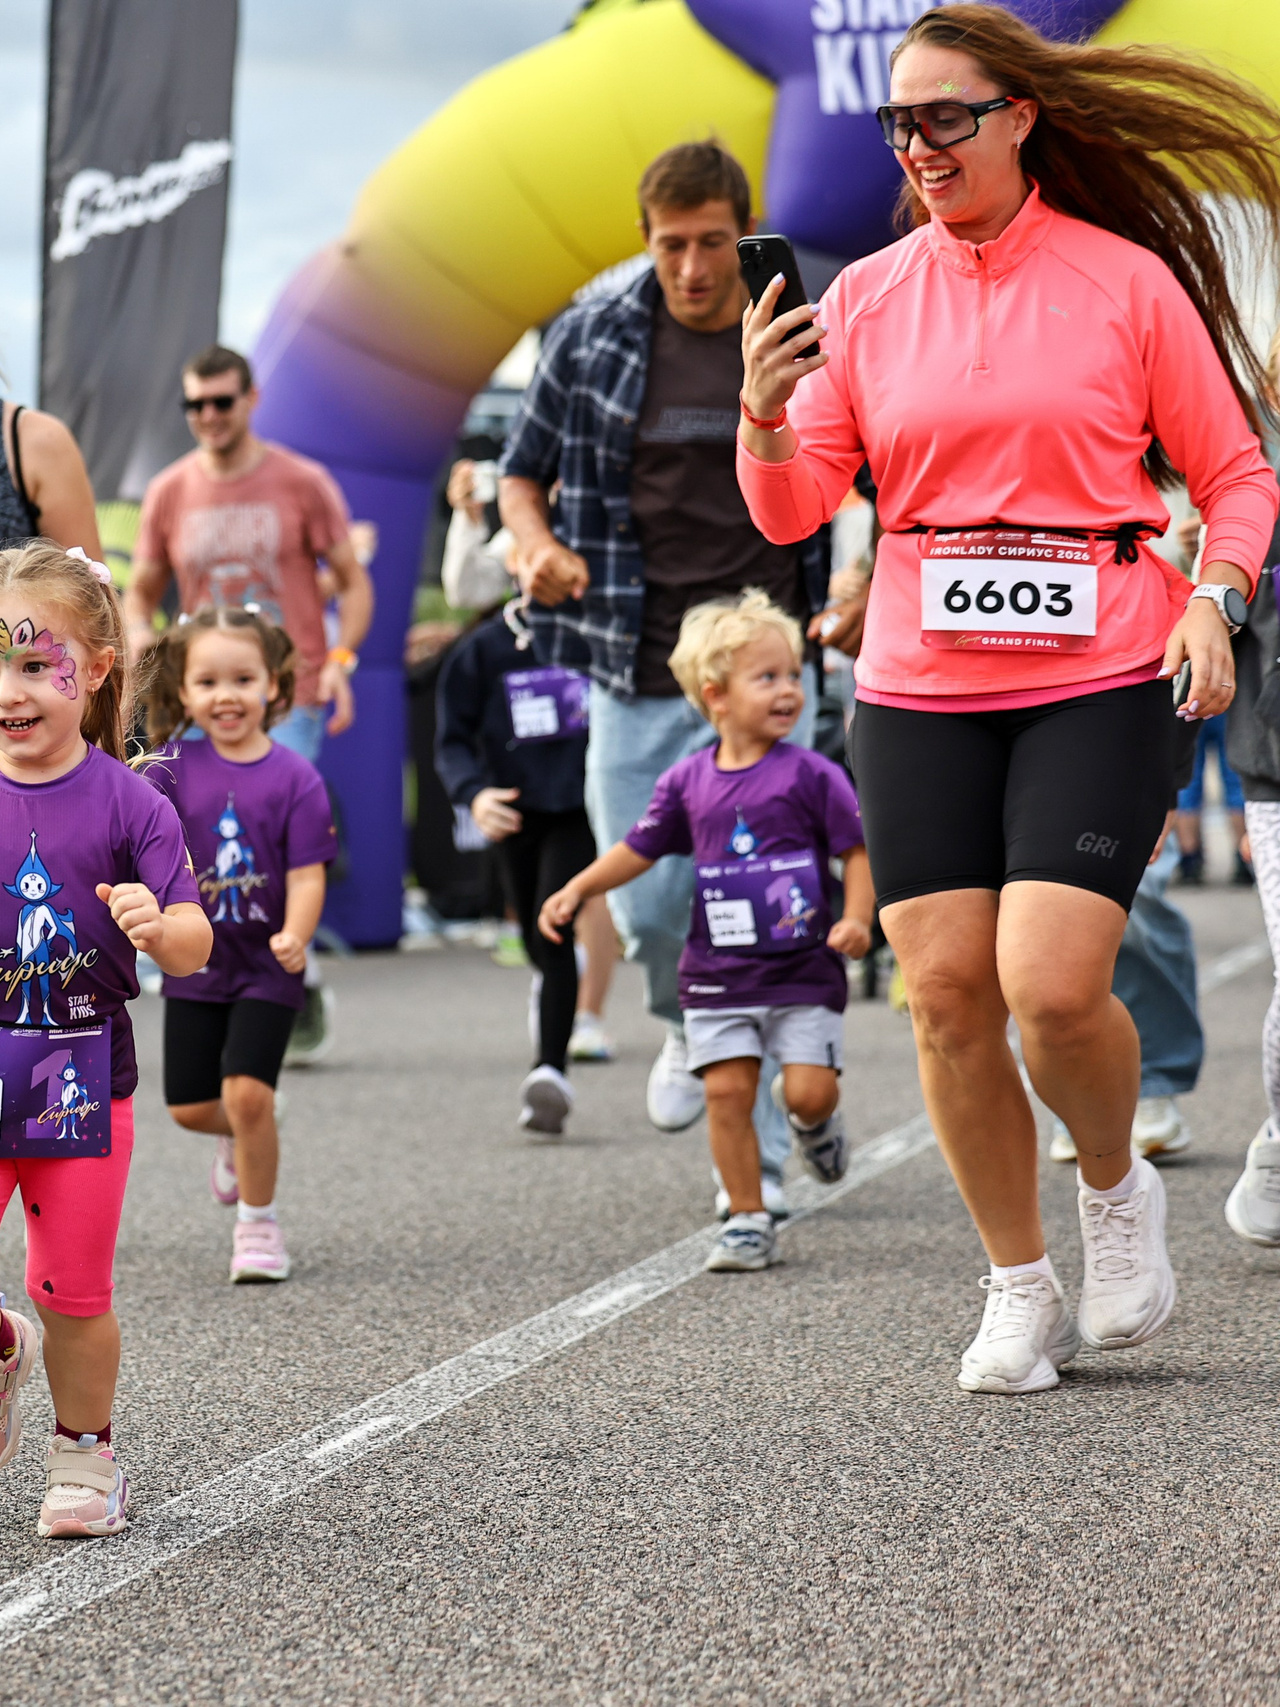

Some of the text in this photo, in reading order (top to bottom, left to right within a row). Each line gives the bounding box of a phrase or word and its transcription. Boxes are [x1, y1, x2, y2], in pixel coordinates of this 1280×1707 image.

[813, 31, 905, 115] KI
[929, 545, 1091, 561] IRONLADY СИРИУС 2026
[944, 580, 1073, 617] 6603
[981, 636, 1060, 648] GRAND FINAL
[68, 994, 89, 1008] STAR
[69, 1004, 97, 1020] KIDS
